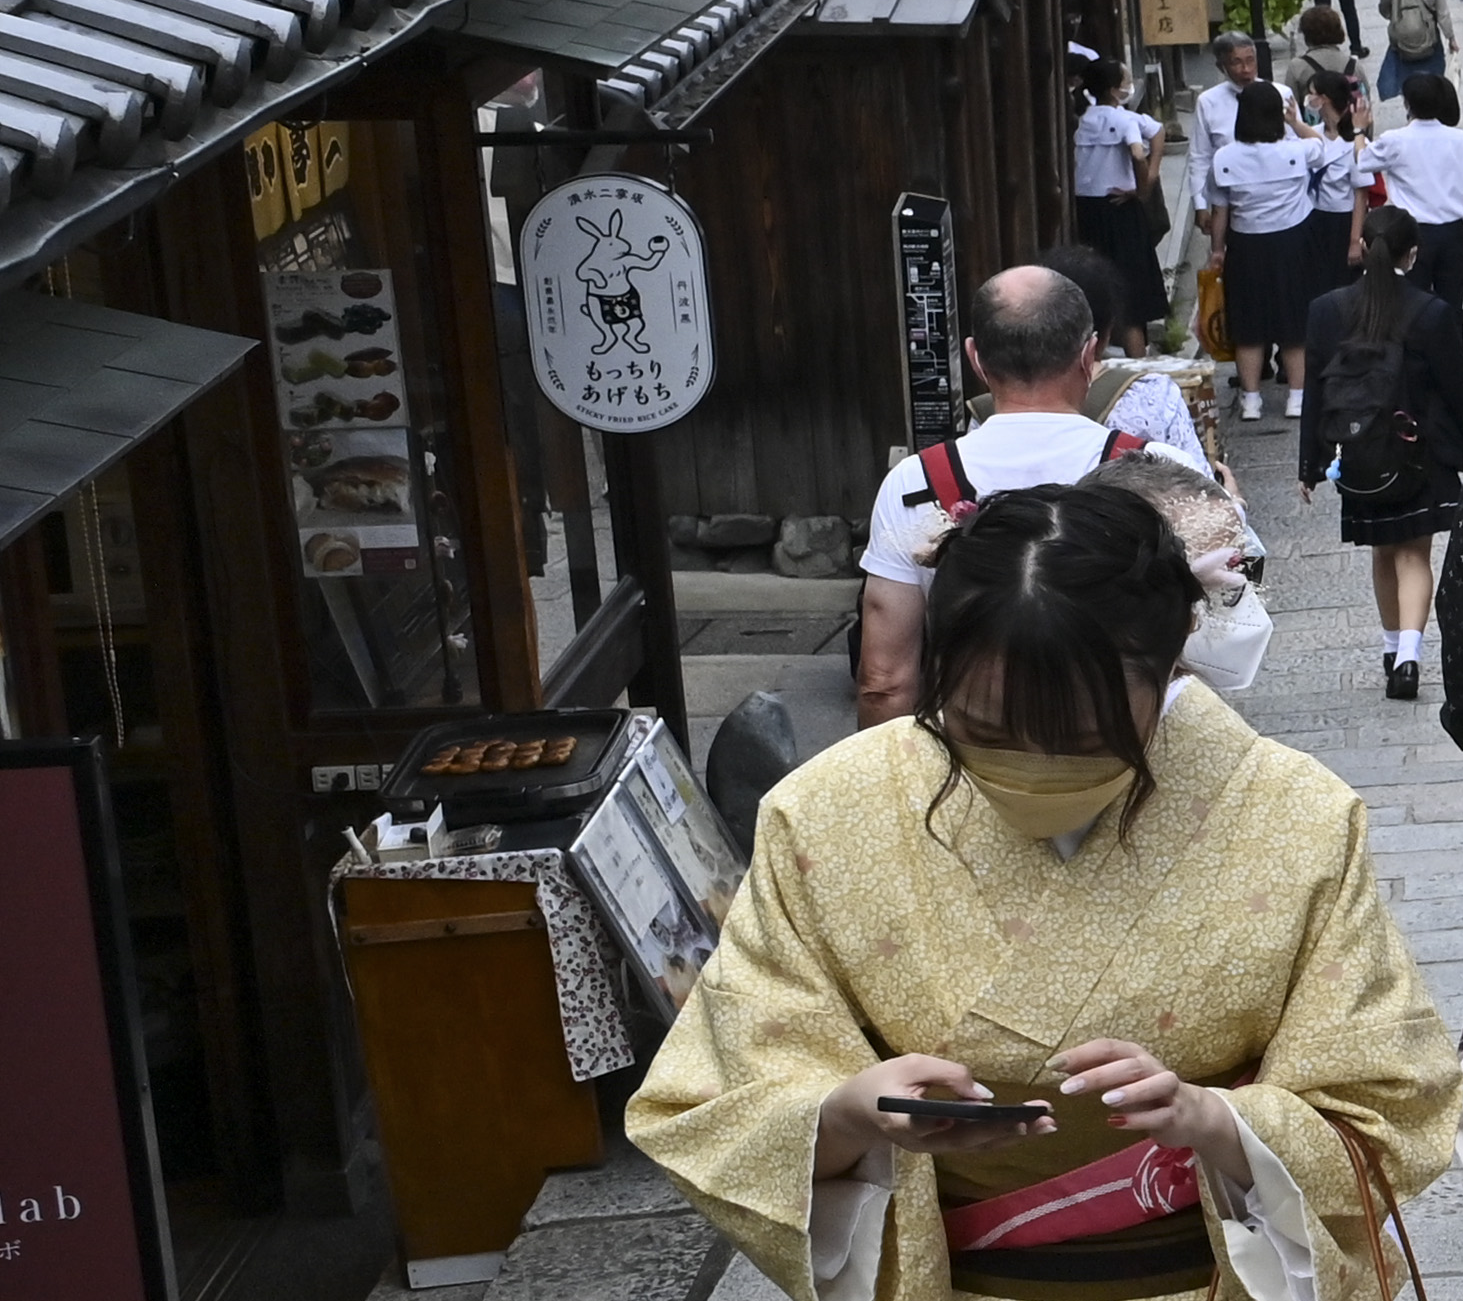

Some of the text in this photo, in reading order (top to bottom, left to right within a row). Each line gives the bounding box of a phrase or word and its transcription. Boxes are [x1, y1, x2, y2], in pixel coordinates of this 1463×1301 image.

[585, 360, 662, 382] もっちり
[581, 382, 671, 406] あげもち
